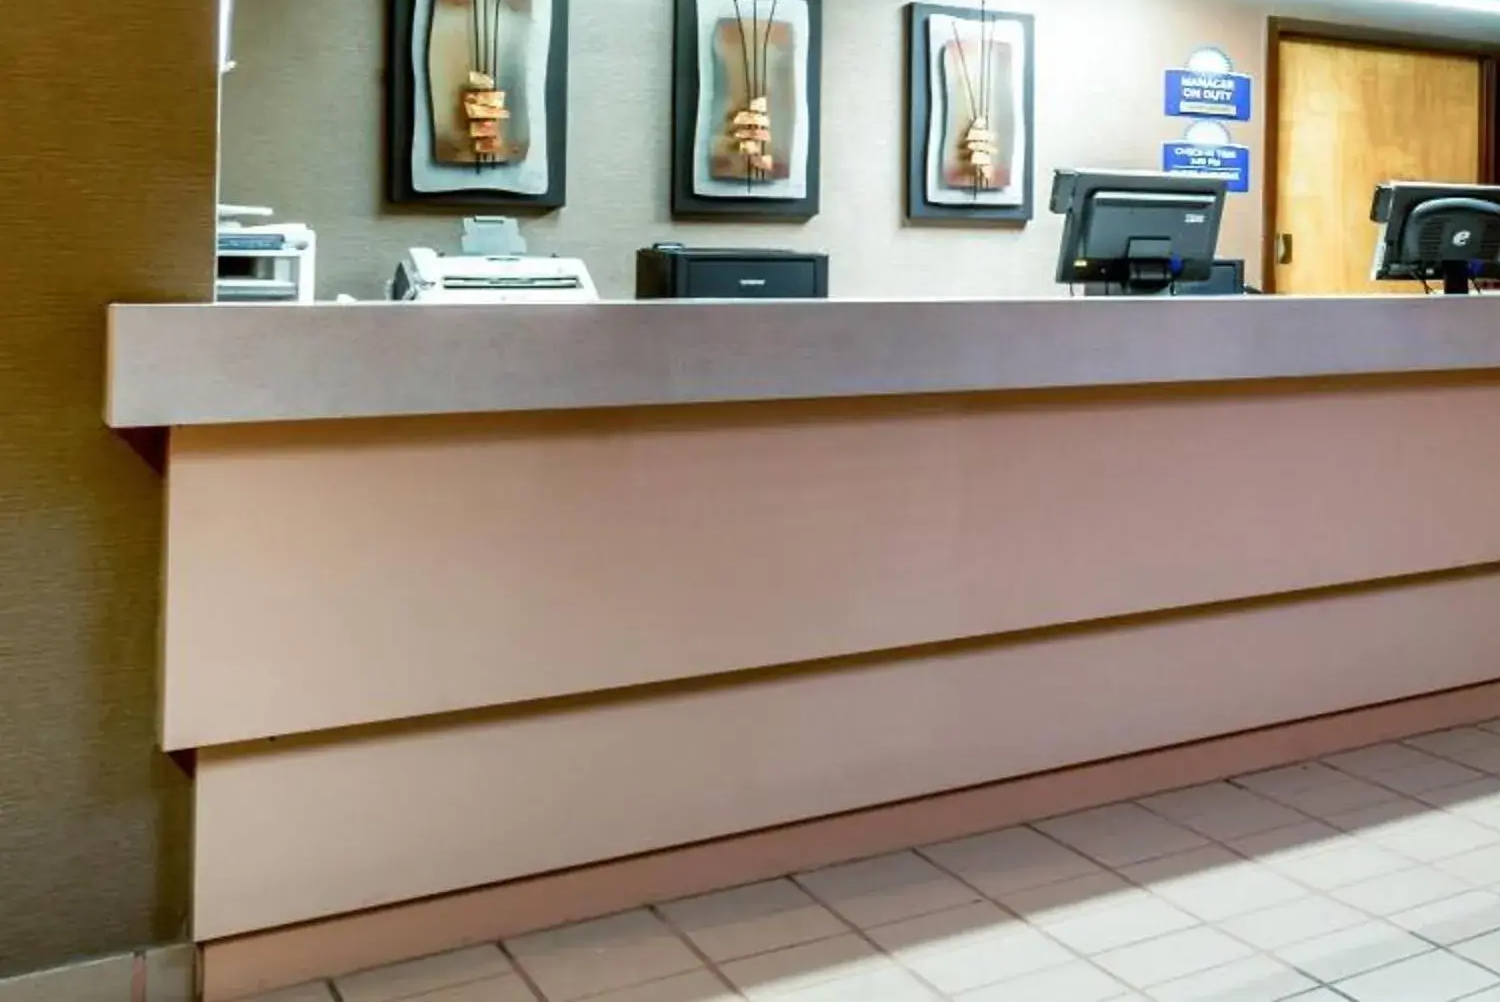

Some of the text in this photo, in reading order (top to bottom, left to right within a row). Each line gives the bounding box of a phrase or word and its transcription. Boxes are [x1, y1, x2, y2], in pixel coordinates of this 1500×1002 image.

[1181, 77, 1235, 89] MANAGER
[1183, 89, 1232, 100] ON DUTY
